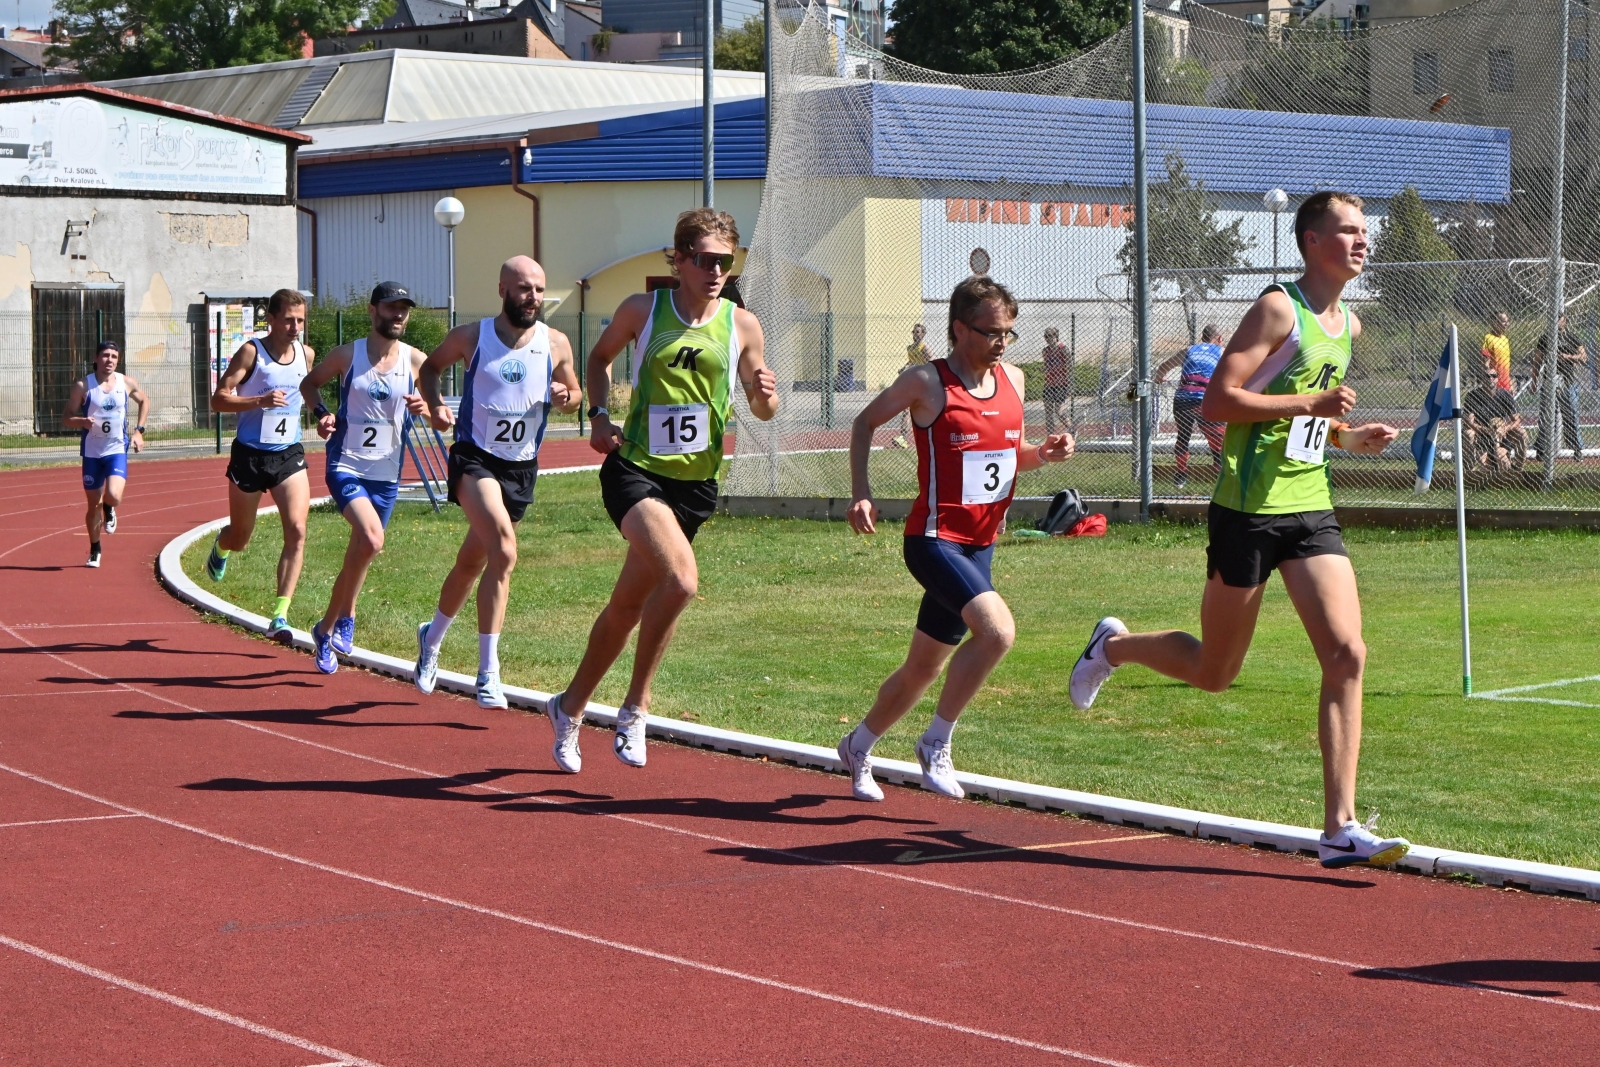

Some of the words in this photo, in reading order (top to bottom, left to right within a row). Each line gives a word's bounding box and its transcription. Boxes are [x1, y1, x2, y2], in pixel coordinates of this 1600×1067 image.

[76, 167, 98, 175] SOKOL
[101, 421, 111, 434] 6
[274, 418, 287, 436] 4
[362, 427, 377, 447] 2
[494, 419, 526, 443] 20
[661, 415, 698, 444] 15
[1303, 417, 1326, 451] 16
[983, 462, 1000, 492] 3
